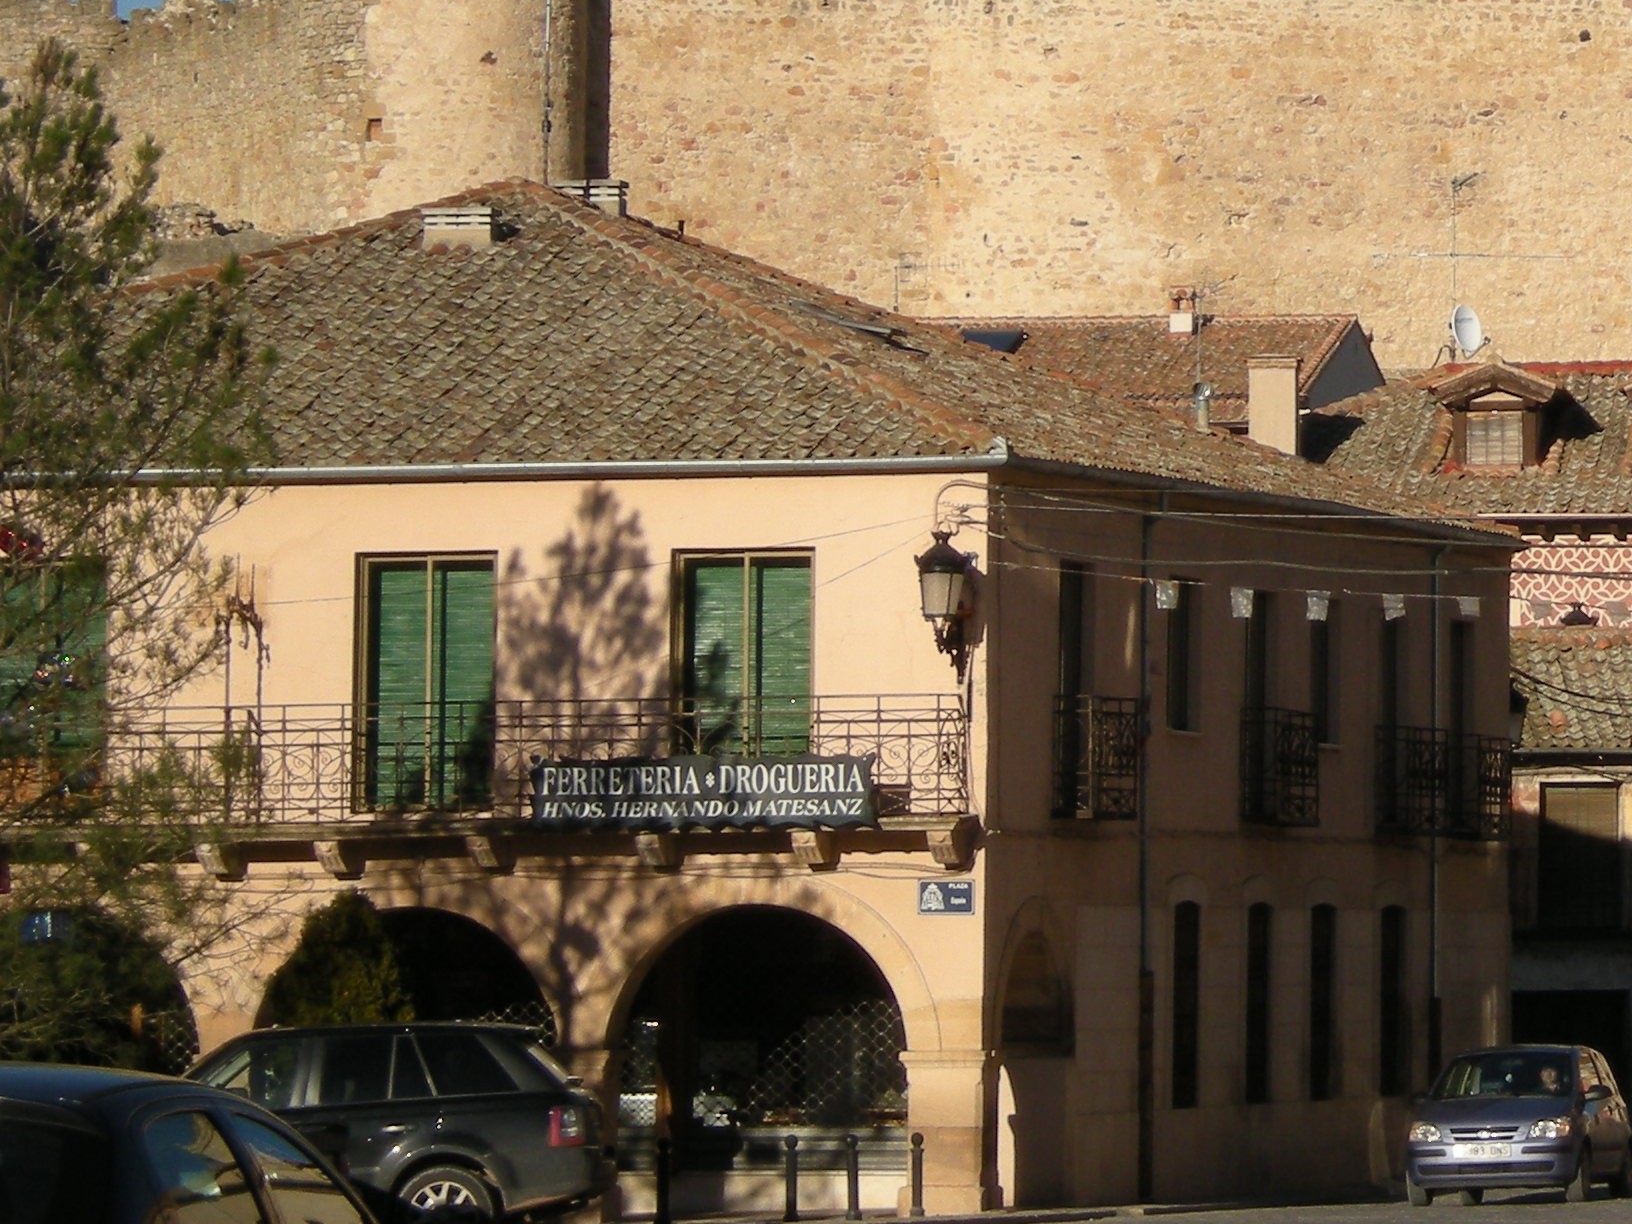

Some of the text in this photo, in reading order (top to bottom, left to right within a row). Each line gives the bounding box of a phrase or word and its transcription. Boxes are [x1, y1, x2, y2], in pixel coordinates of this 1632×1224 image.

[541, 763, 865, 797] FERRETERIA DROGUERIA
[541, 798, 864, 819] HNOS. HERNANDO MATESANZ
